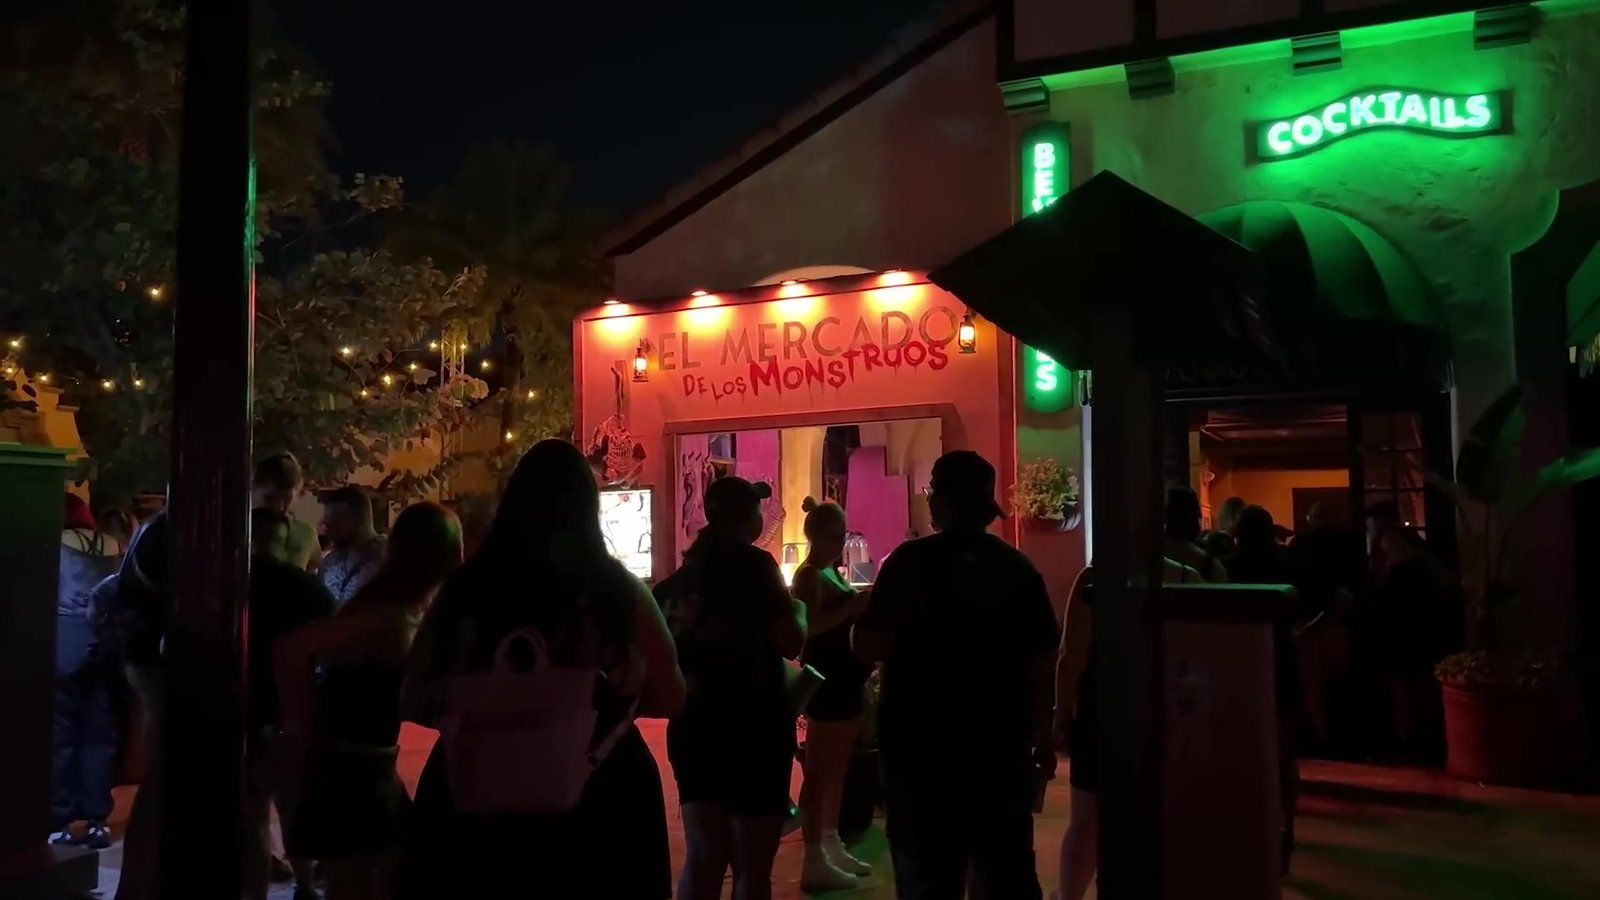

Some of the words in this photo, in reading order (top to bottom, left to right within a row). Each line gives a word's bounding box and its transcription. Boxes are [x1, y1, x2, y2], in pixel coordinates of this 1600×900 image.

[1267, 91, 1491, 154] COCKTAILS
[658, 331, 702, 371] EL
[720, 305, 959, 366] MERCADO
[682, 374, 708, 397] DE
[711, 376, 747, 403] LOS
[749, 340, 949, 397] MONSTRUOS
